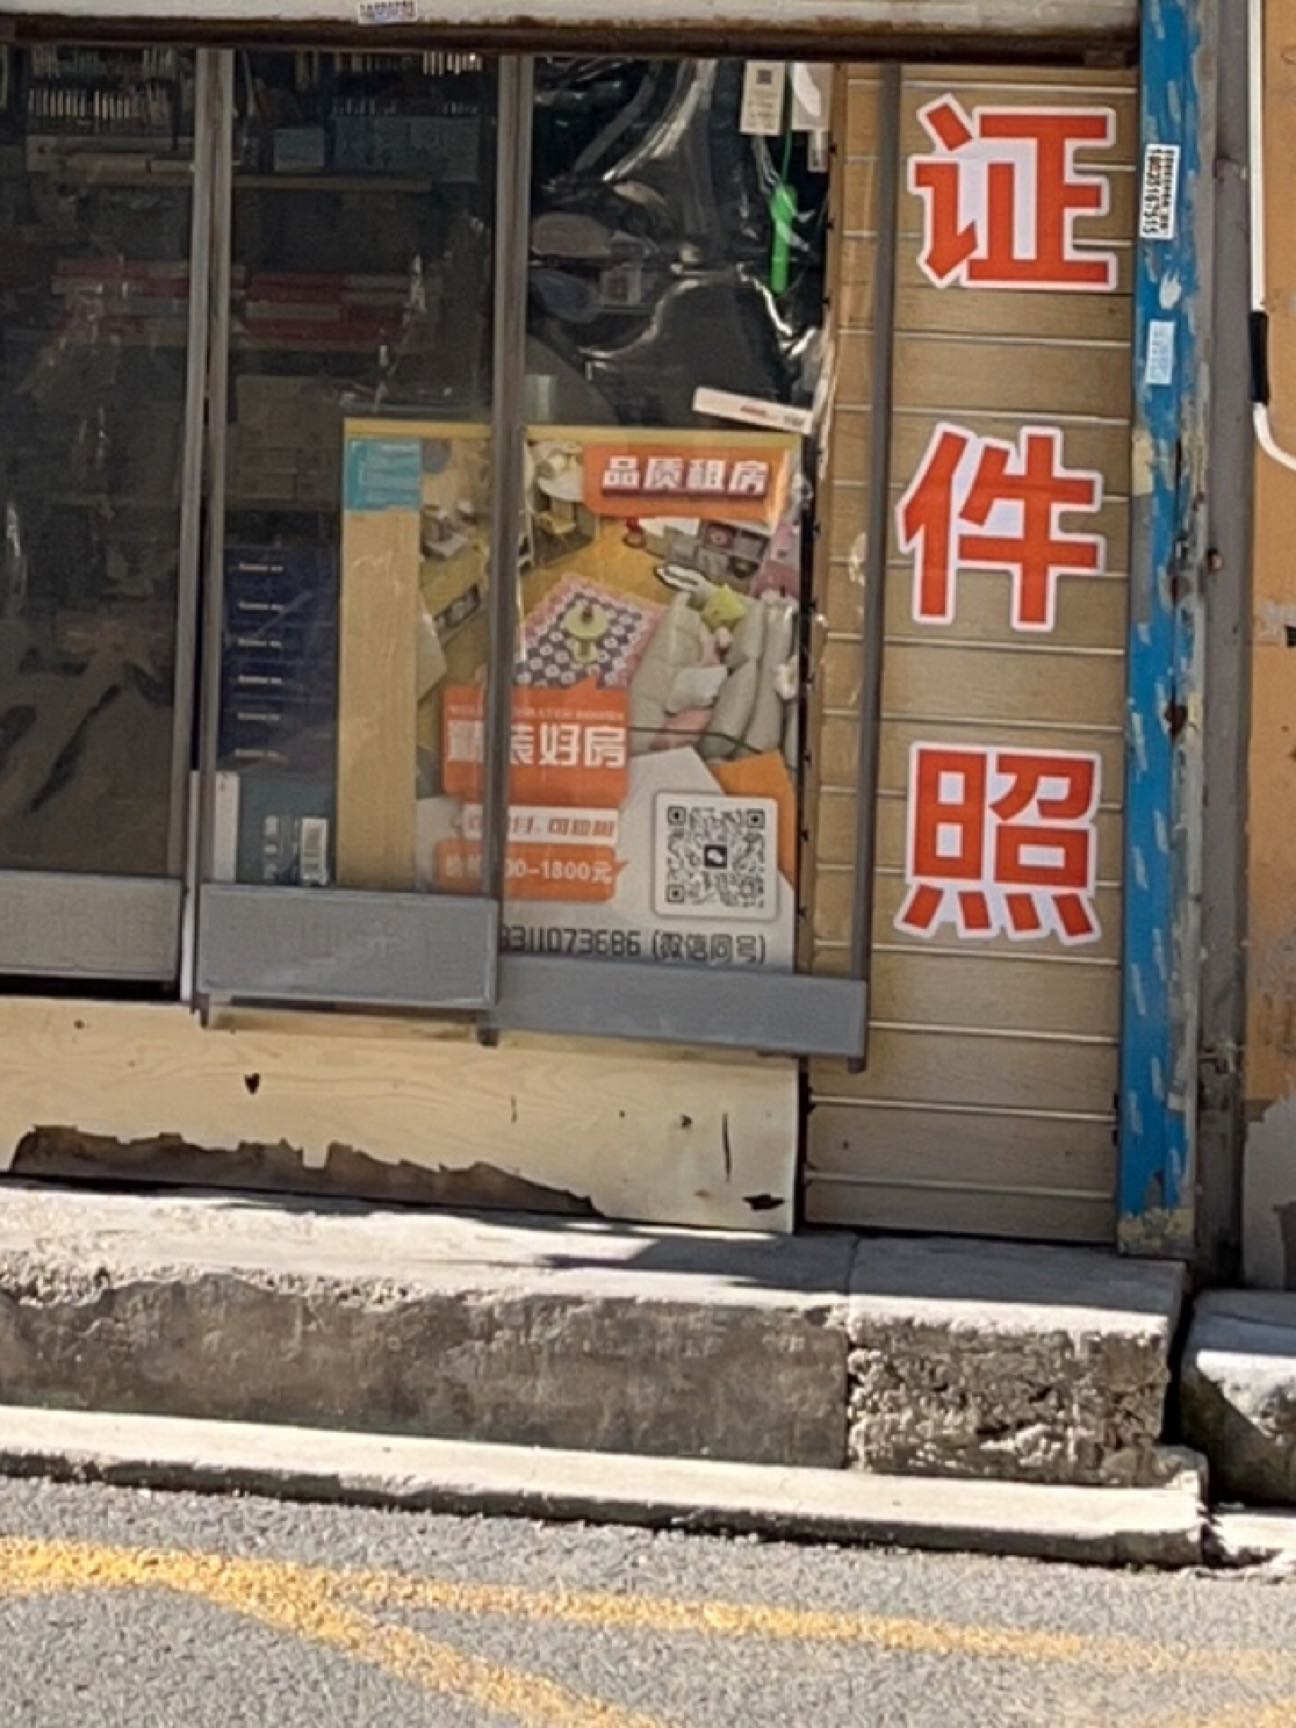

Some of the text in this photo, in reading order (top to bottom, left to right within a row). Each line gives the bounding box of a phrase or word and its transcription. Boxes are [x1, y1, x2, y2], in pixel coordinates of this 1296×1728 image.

[602, 455, 770, 494] 品质租房
[904, 102, 1112, 938] 证件照
